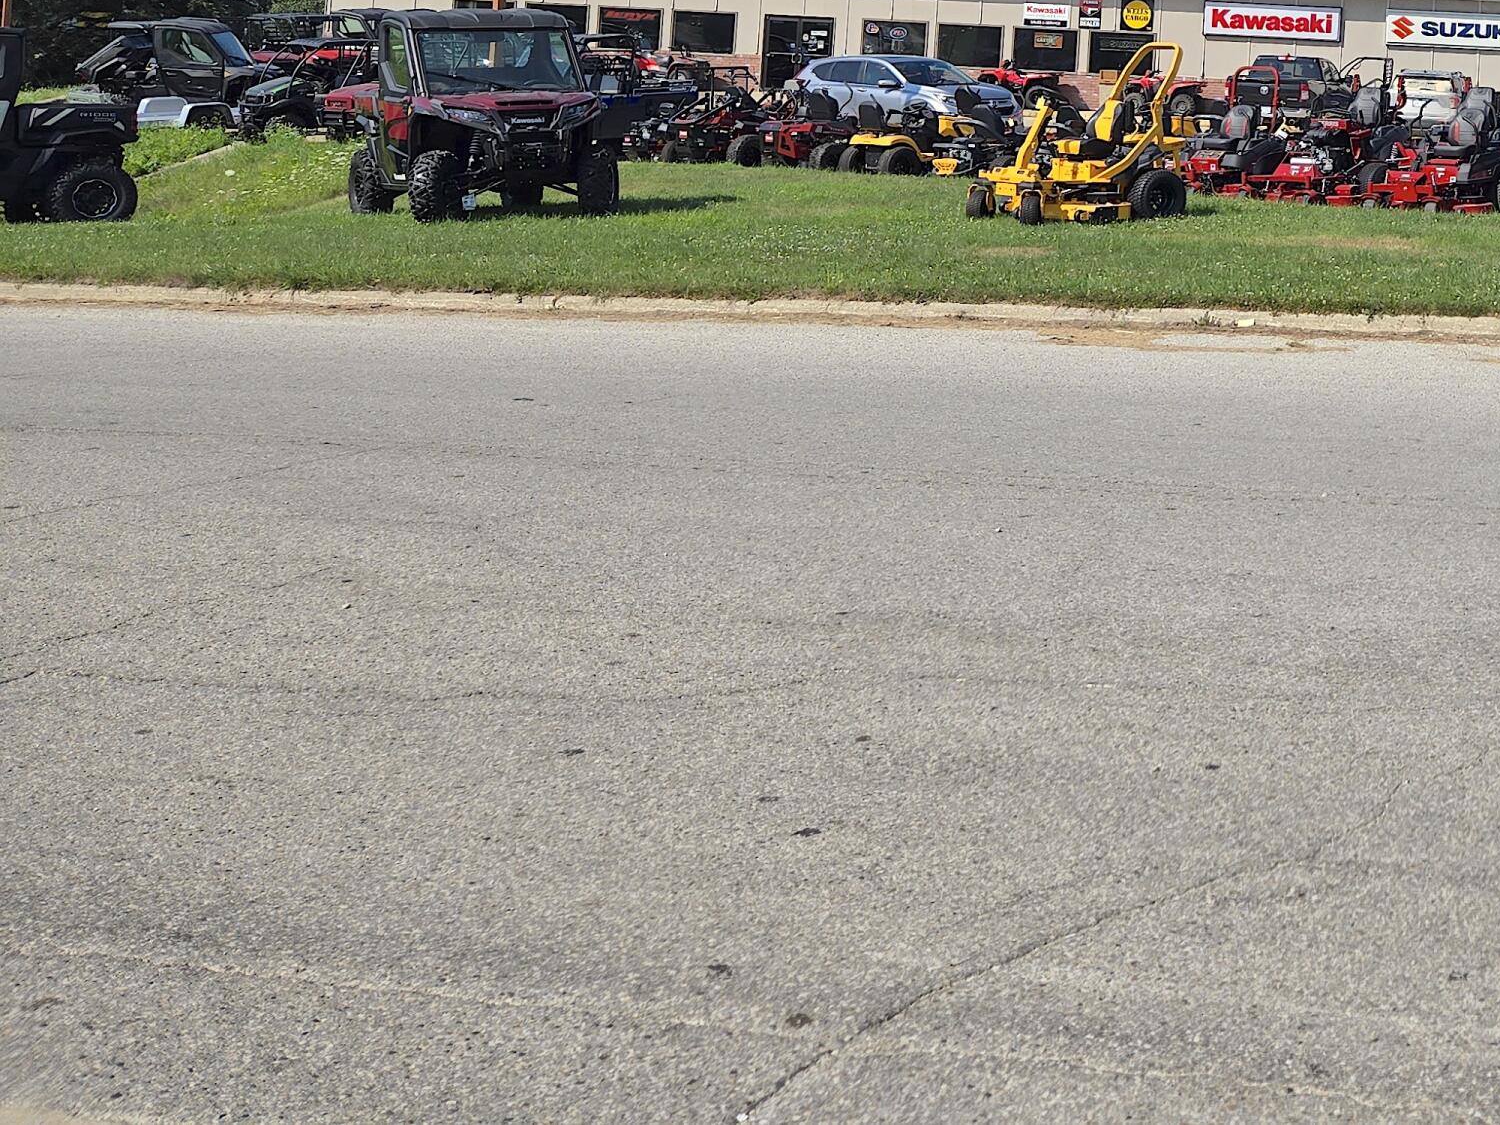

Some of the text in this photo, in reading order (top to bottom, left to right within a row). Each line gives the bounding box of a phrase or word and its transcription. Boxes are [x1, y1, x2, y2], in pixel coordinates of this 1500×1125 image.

[1026, 5, 1066, 15] Kawasaki
[1211, 8, 1333, 34] Kawasaki
[510, 116, 545, 124] Kawasaki
